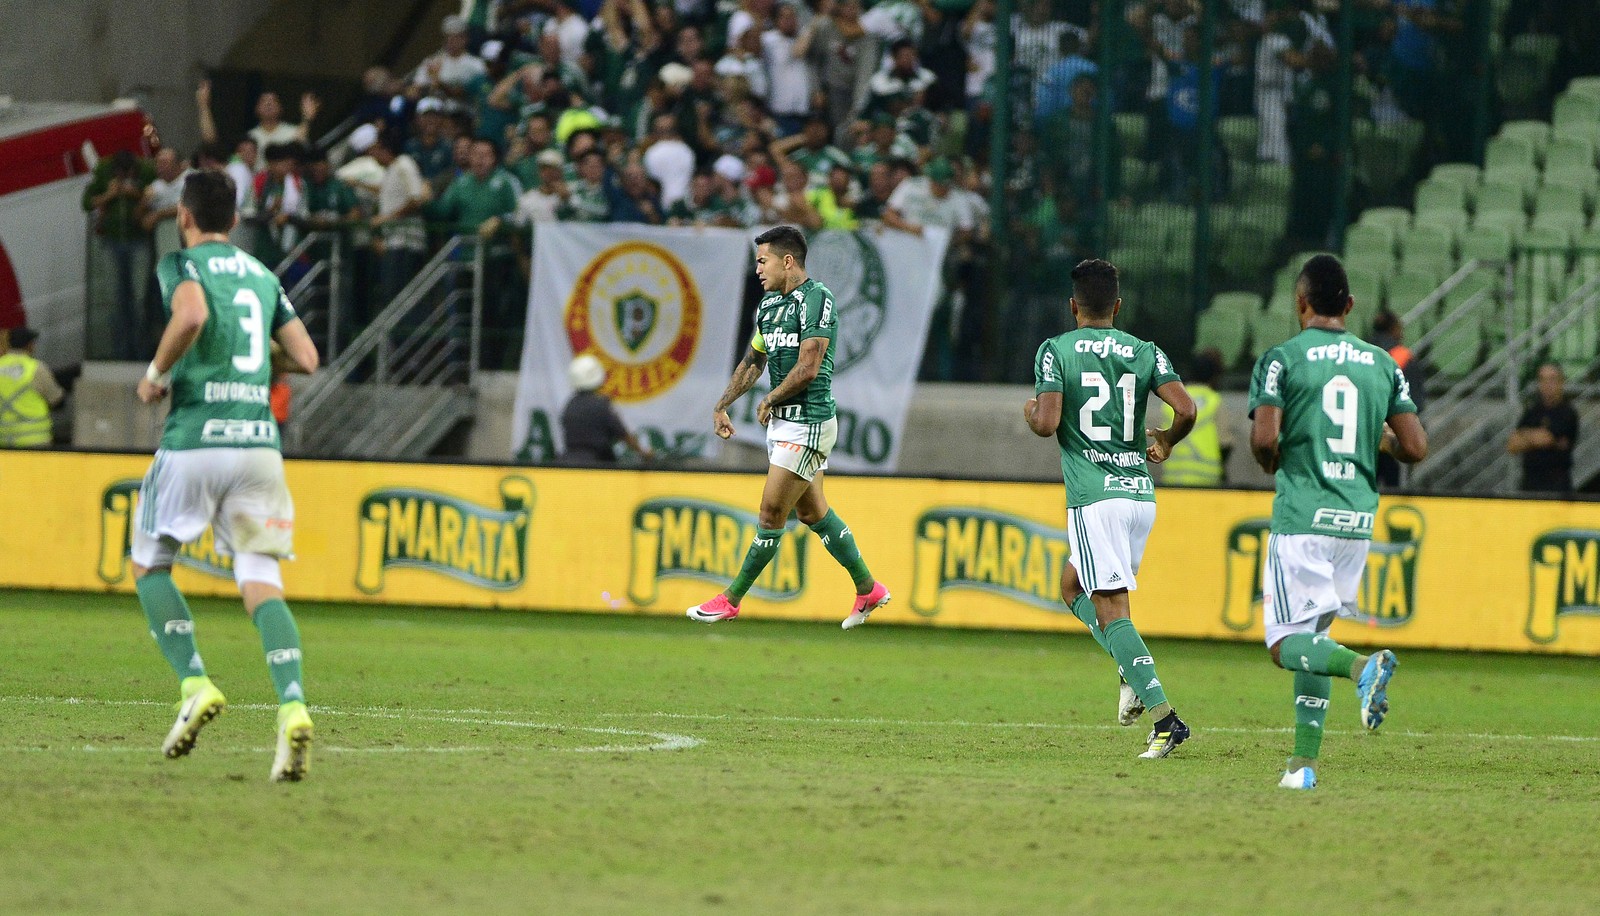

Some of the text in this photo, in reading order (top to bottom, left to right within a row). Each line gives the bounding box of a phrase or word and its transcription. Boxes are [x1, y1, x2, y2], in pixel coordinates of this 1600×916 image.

[232, 287, 265, 373] 3
[762, 327, 800, 352] refisa
[1306, 340, 1375, 365] crefisa
[1079, 371, 1137, 442] 21
[1322, 374, 1359, 454] 9
[1112, 451, 1145, 468] SANTOS
[1132, 655, 1155, 667] Fa
